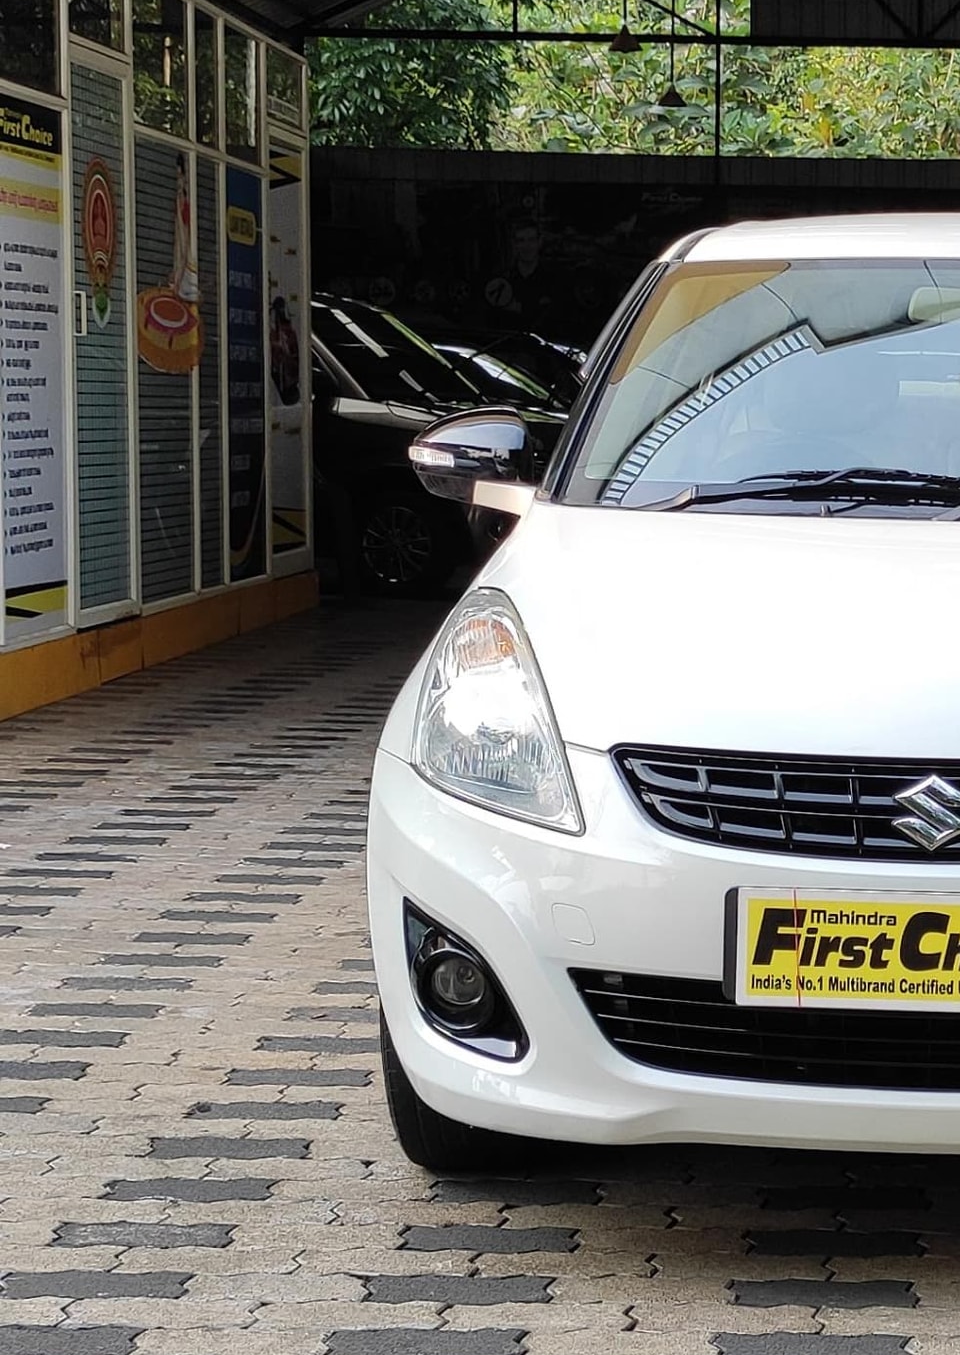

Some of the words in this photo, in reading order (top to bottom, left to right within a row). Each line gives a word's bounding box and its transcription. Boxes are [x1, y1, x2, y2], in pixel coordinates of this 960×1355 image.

[21, 114, 53, 147] Choice
[811, 909, 897, 926] Mahindra
[752, 908, 895, 969] First
[751, 974, 792, 990] India's
[796, 976, 824, 991] No.1
[828, 976, 895, 993] Multibrand
[899, 979, 953, 995] Certified
